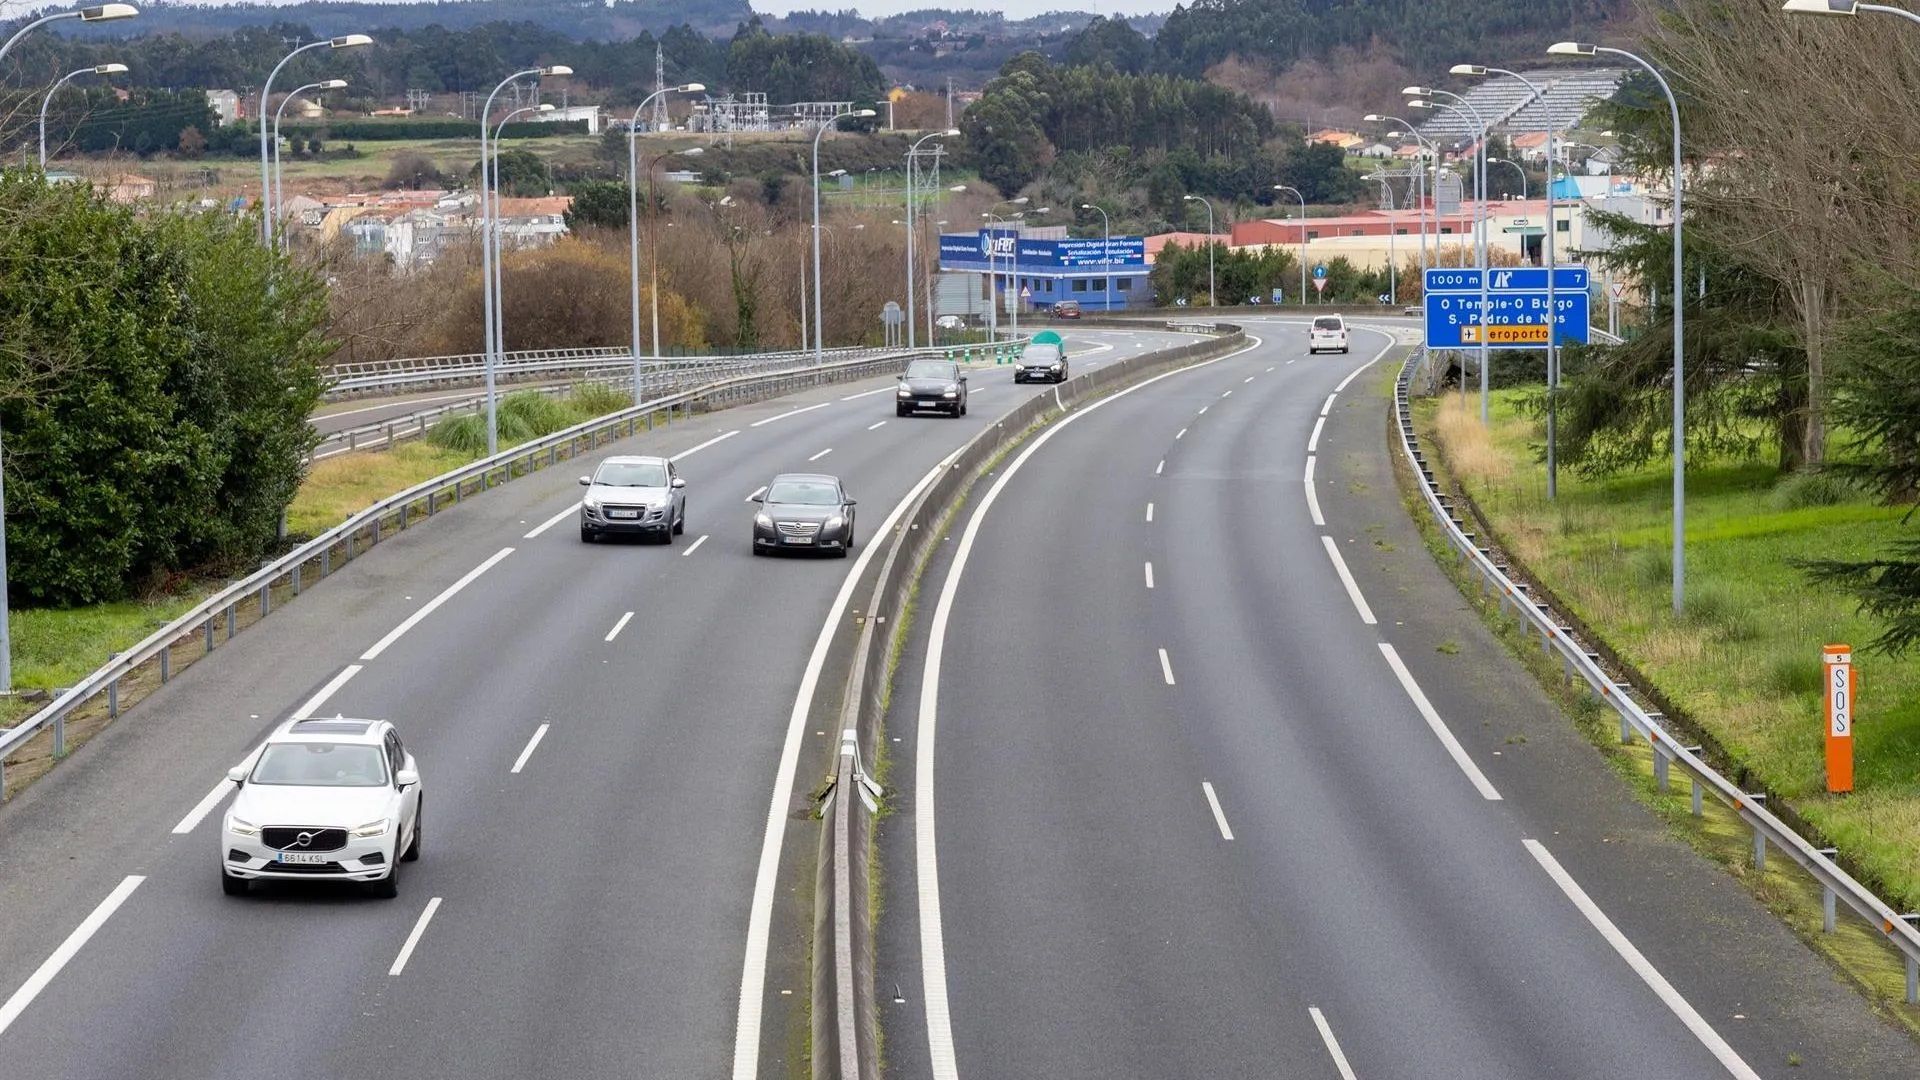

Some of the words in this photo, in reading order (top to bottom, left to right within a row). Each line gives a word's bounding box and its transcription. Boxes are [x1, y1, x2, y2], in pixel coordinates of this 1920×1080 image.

[1432, 275, 1463, 284] 1000
[1469, 276, 1478, 284] m
[1574, 274, 1581, 283] 7
[1441, 298, 1450, 310] O
[1448, 313, 1462, 324] S.
[1517, 313, 1532, 324] de
[1489, 328, 1548, 341] eroporto
[1836, 654, 1842, 662] 5
[1835, 669, 1845, 733] SOS
[285, 854, 306, 863] 6614
[309, 854, 326, 863] KSL
